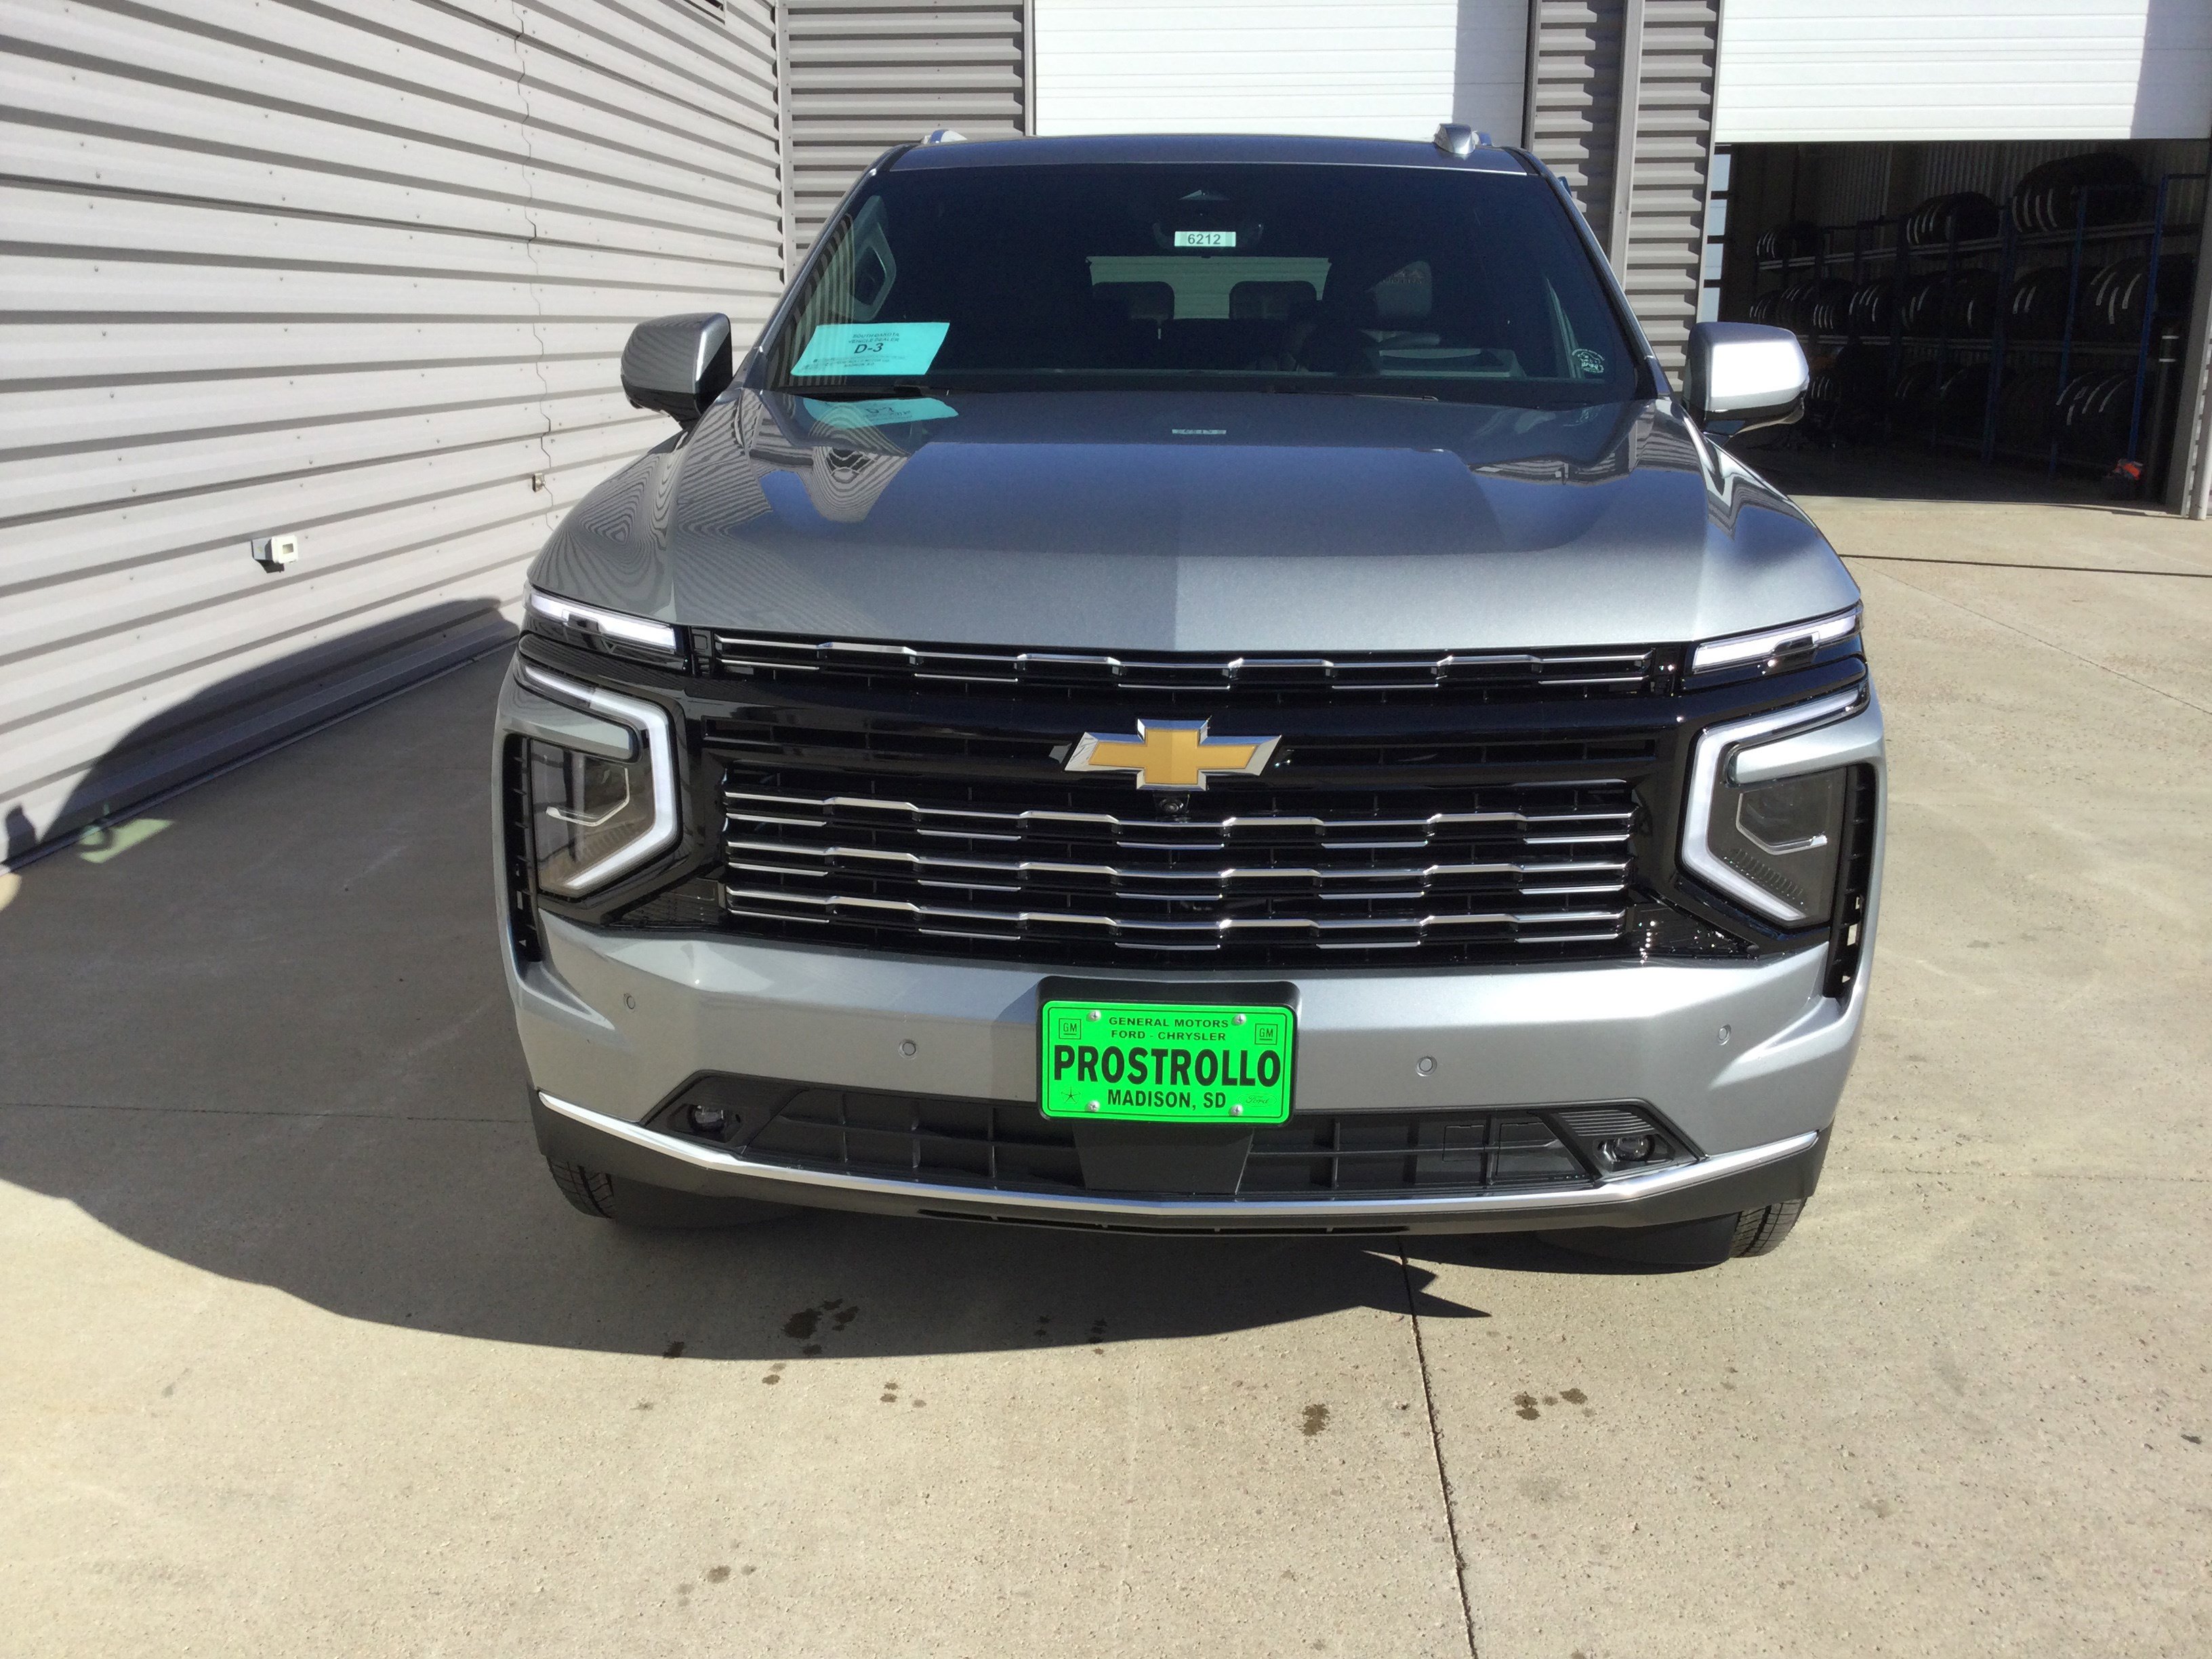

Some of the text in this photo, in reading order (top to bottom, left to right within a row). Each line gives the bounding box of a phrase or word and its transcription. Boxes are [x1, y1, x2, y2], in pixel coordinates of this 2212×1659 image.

[1187, 233, 1221, 245] 6212
[854, 342, 884, 354] D-3
[1063, 1023, 1078, 1033] GM
[1109, 1017, 1229, 1028] GENERAL MOTORS
[1111, 1029, 1146, 1040] FORD
[1158, 1031, 1226, 1041] CHRYSLER
[1259, 1028, 1274, 1038] GM
[1054, 1044, 1281, 1088] PROSTROLLO
[1107, 1089, 1226, 1111] MADISON, SD
[1245, 1094, 1270, 1105] Ford
